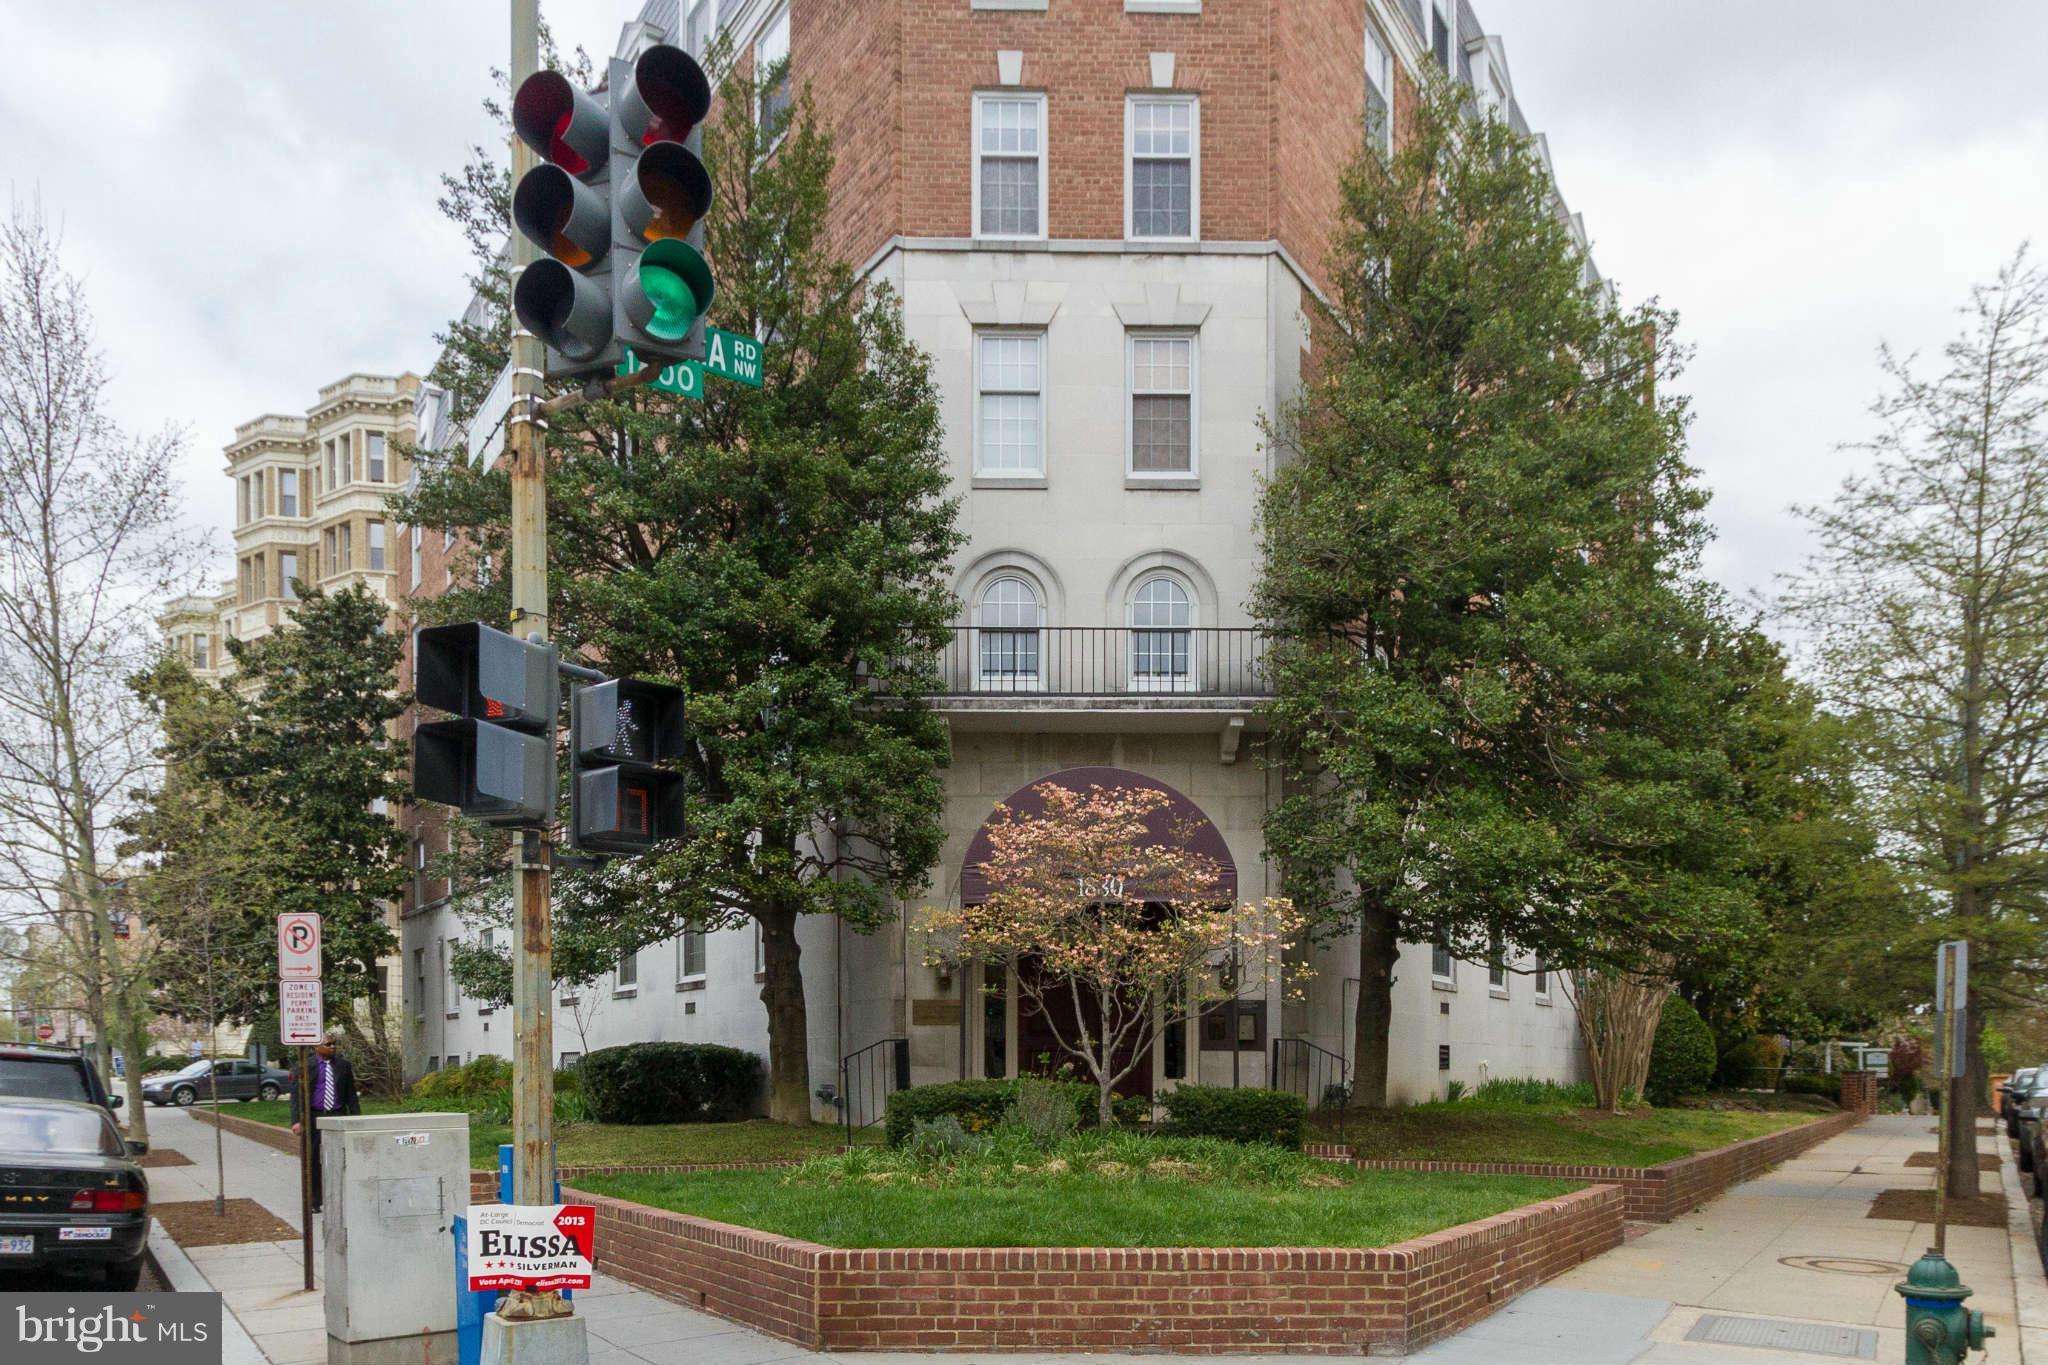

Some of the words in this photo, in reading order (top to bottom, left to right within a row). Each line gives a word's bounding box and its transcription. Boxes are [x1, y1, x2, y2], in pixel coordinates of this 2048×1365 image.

[734, 340, 757, 361] RD
[734, 358, 757, 379] NW
[292, 926, 308, 948] P
[558, 1216, 586, 1226] 2013
[479, 1230, 583, 1258] ELISSA
[516, 1261, 578, 1272] SILVERMAN
[479, 1278, 497, 1286] Vote
